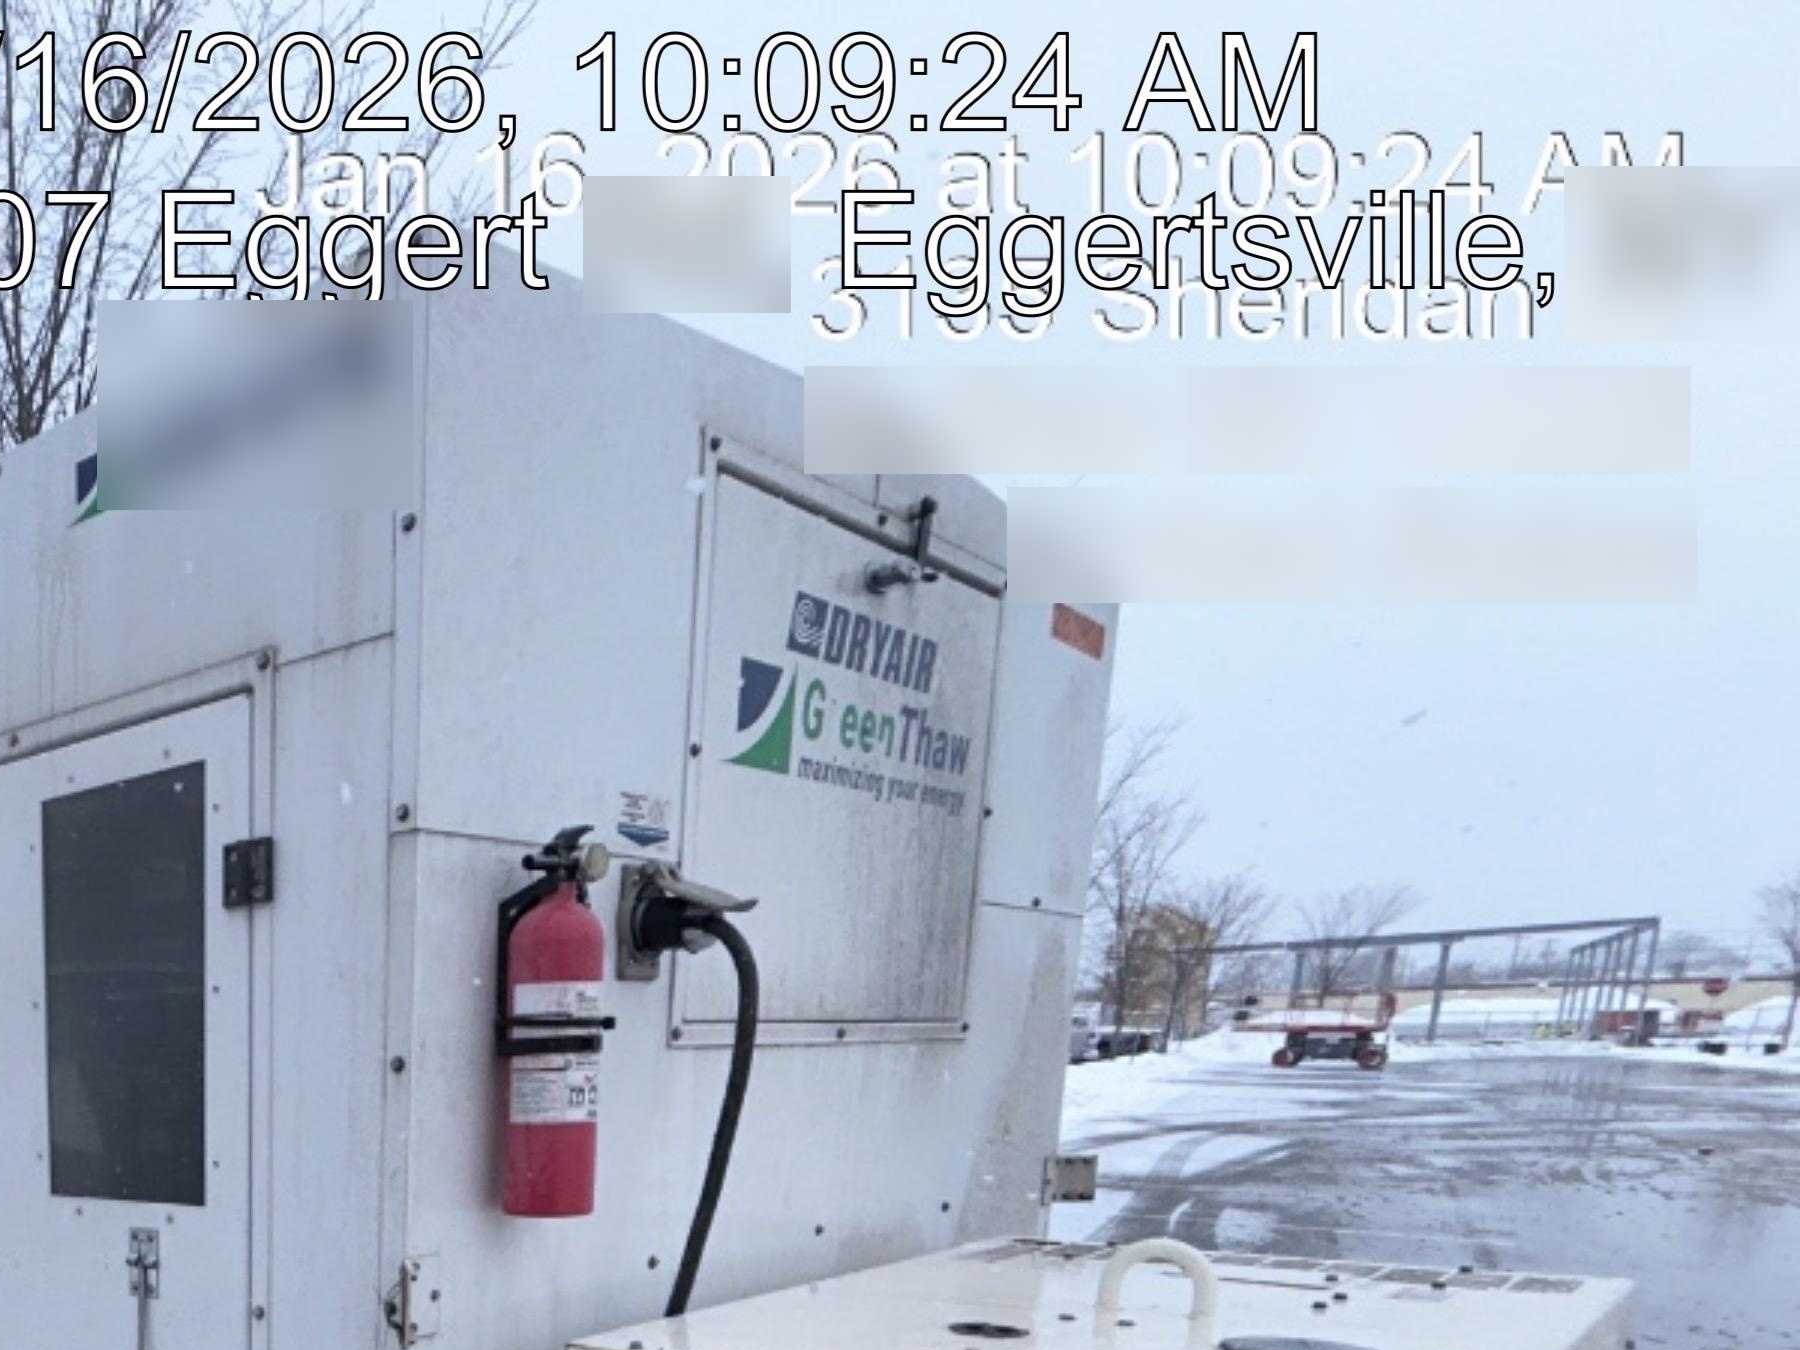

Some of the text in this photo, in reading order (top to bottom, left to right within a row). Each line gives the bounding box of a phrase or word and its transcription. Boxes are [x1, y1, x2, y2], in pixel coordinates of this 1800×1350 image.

[823, 604, 937, 693] DRYAIR
[803, 678, 971, 775] Geen Thaw
[798, 756, 884, 801] maximizing
